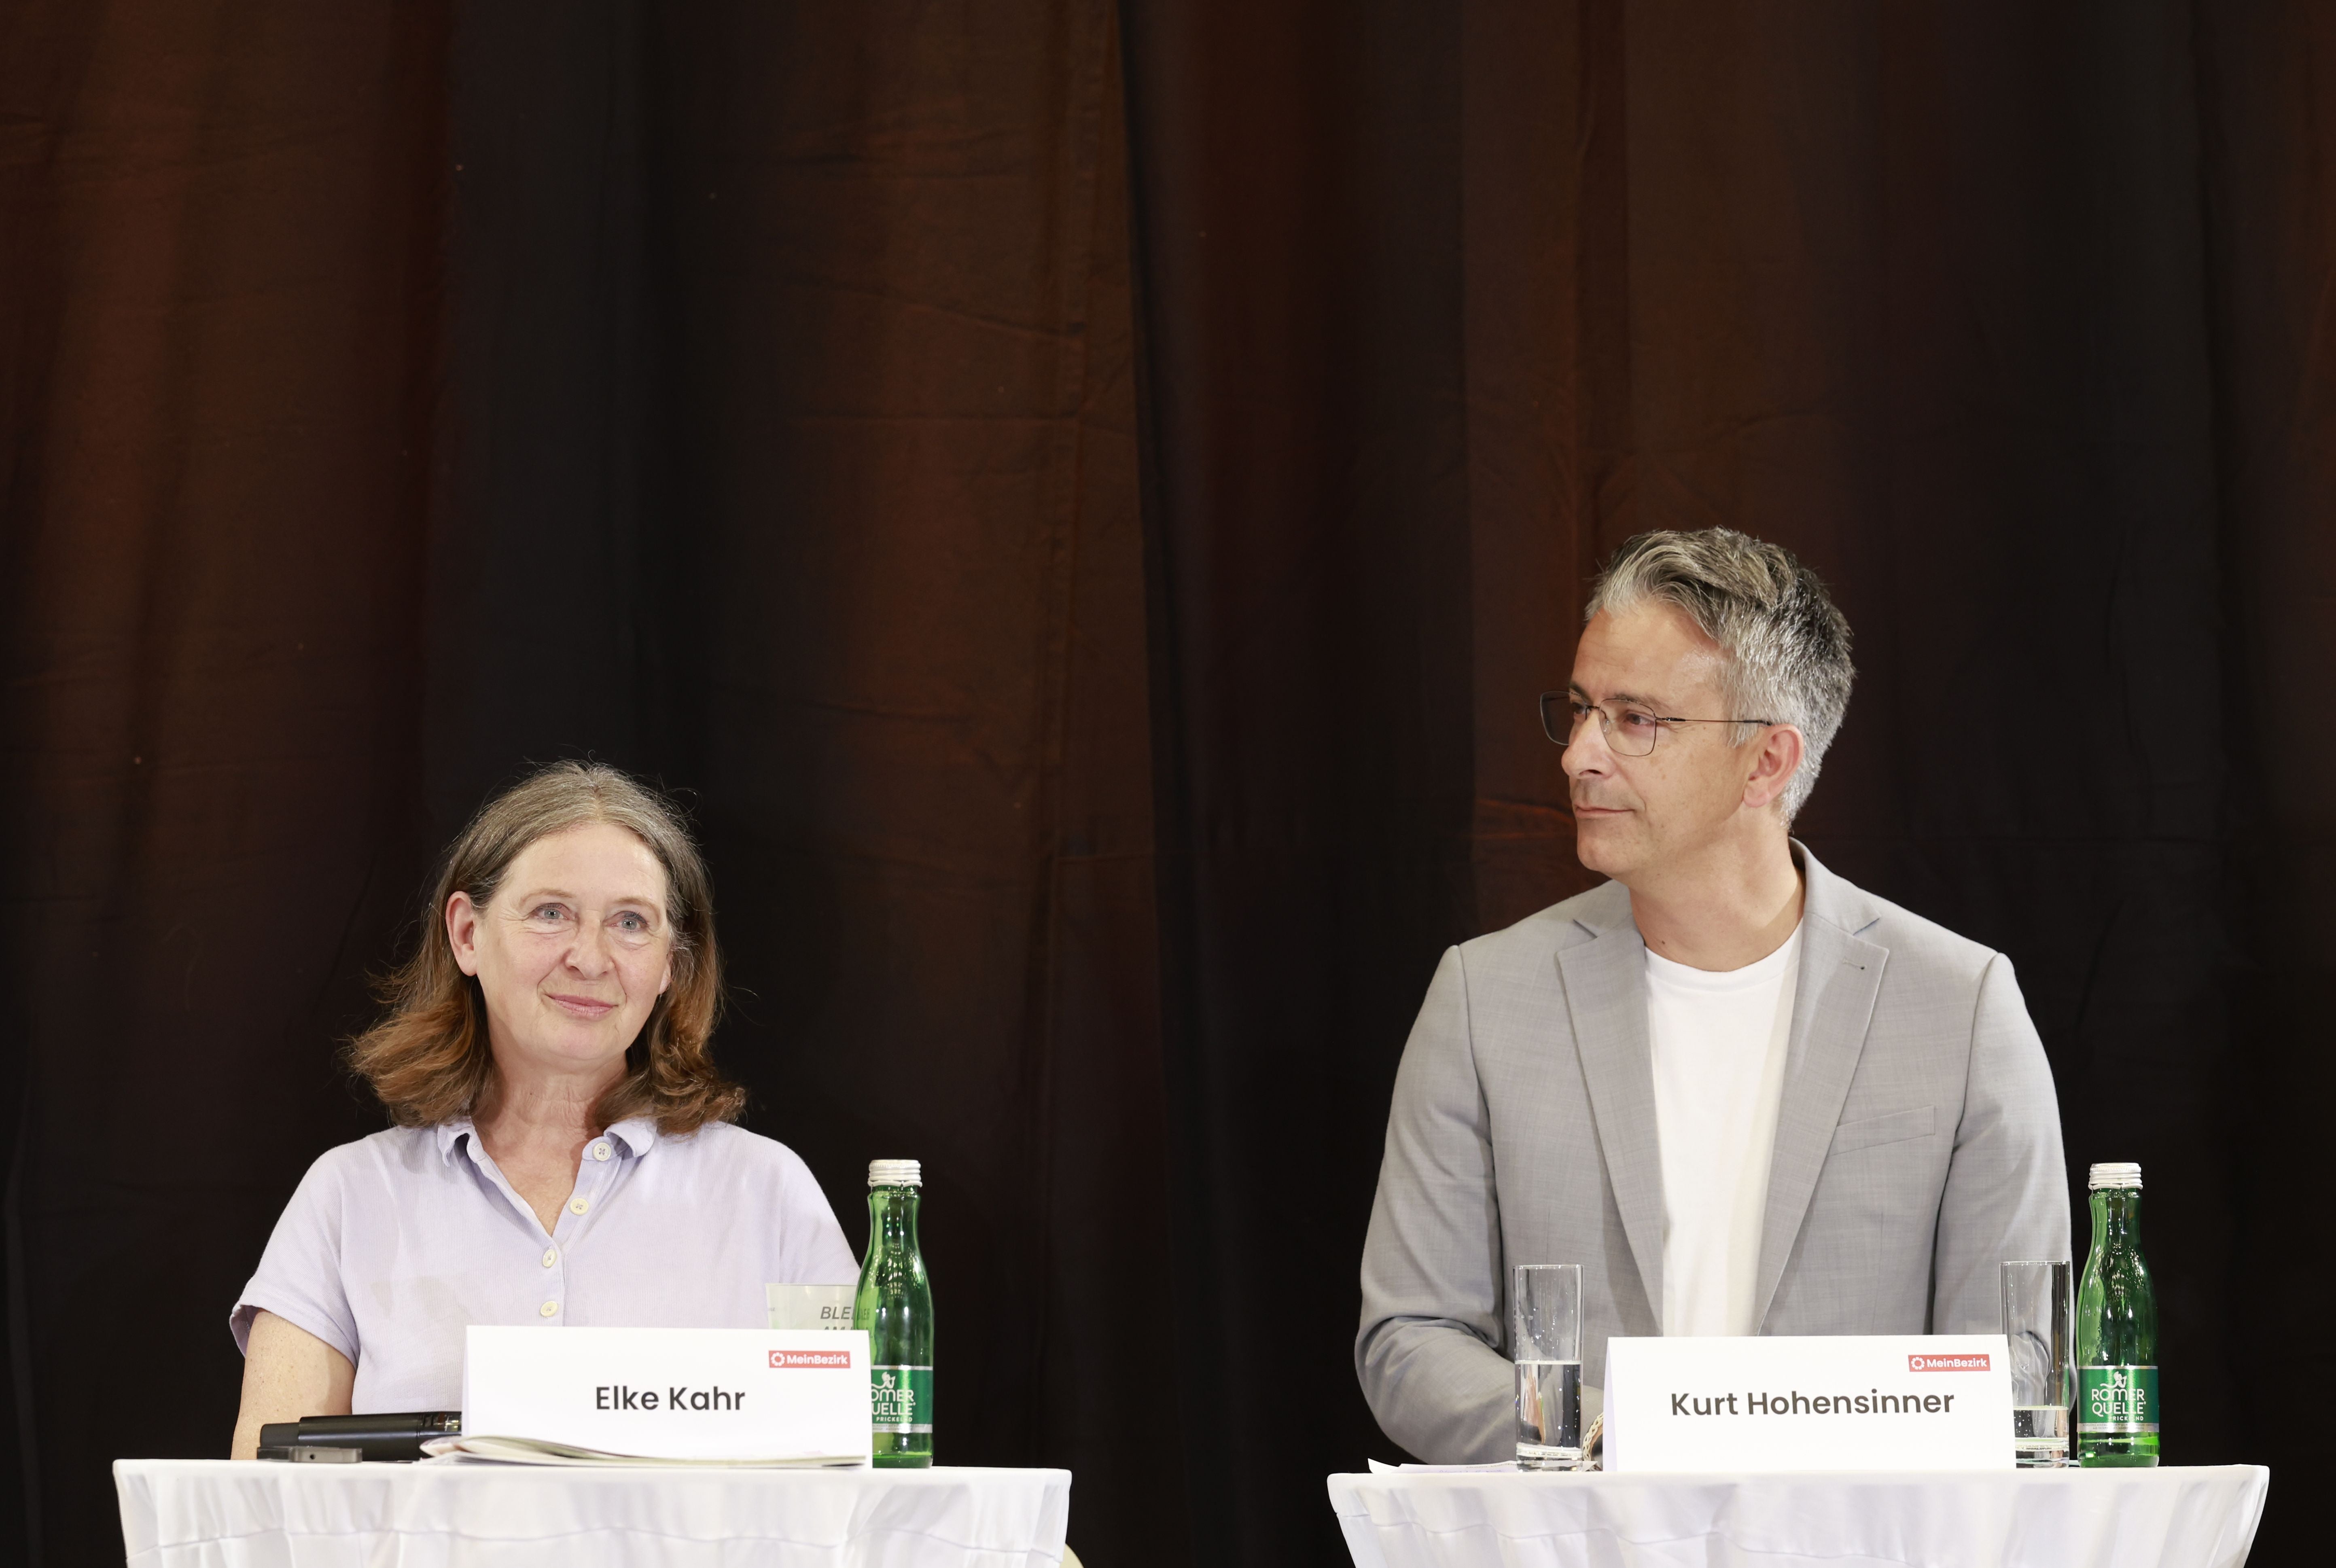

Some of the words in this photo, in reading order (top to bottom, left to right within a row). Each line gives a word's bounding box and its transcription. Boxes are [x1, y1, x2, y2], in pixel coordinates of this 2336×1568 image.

[786, 1354, 848, 1365] MeinBezirk
[1926, 1358, 1988, 1368] MeinBezirk
[596, 1385, 659, 1411] Elke
[669, 1386, 745, 1411] Kahr
[871, 1389, 914, 1402] OMER
[1671, 1392, 1738, 1415] Kurt
[1747, 1388, 1954, 1415] Hohensinner
[872, 1403, 914, 1415] UELLE
[2092, 1402, 2144, 1418] QUELLE
